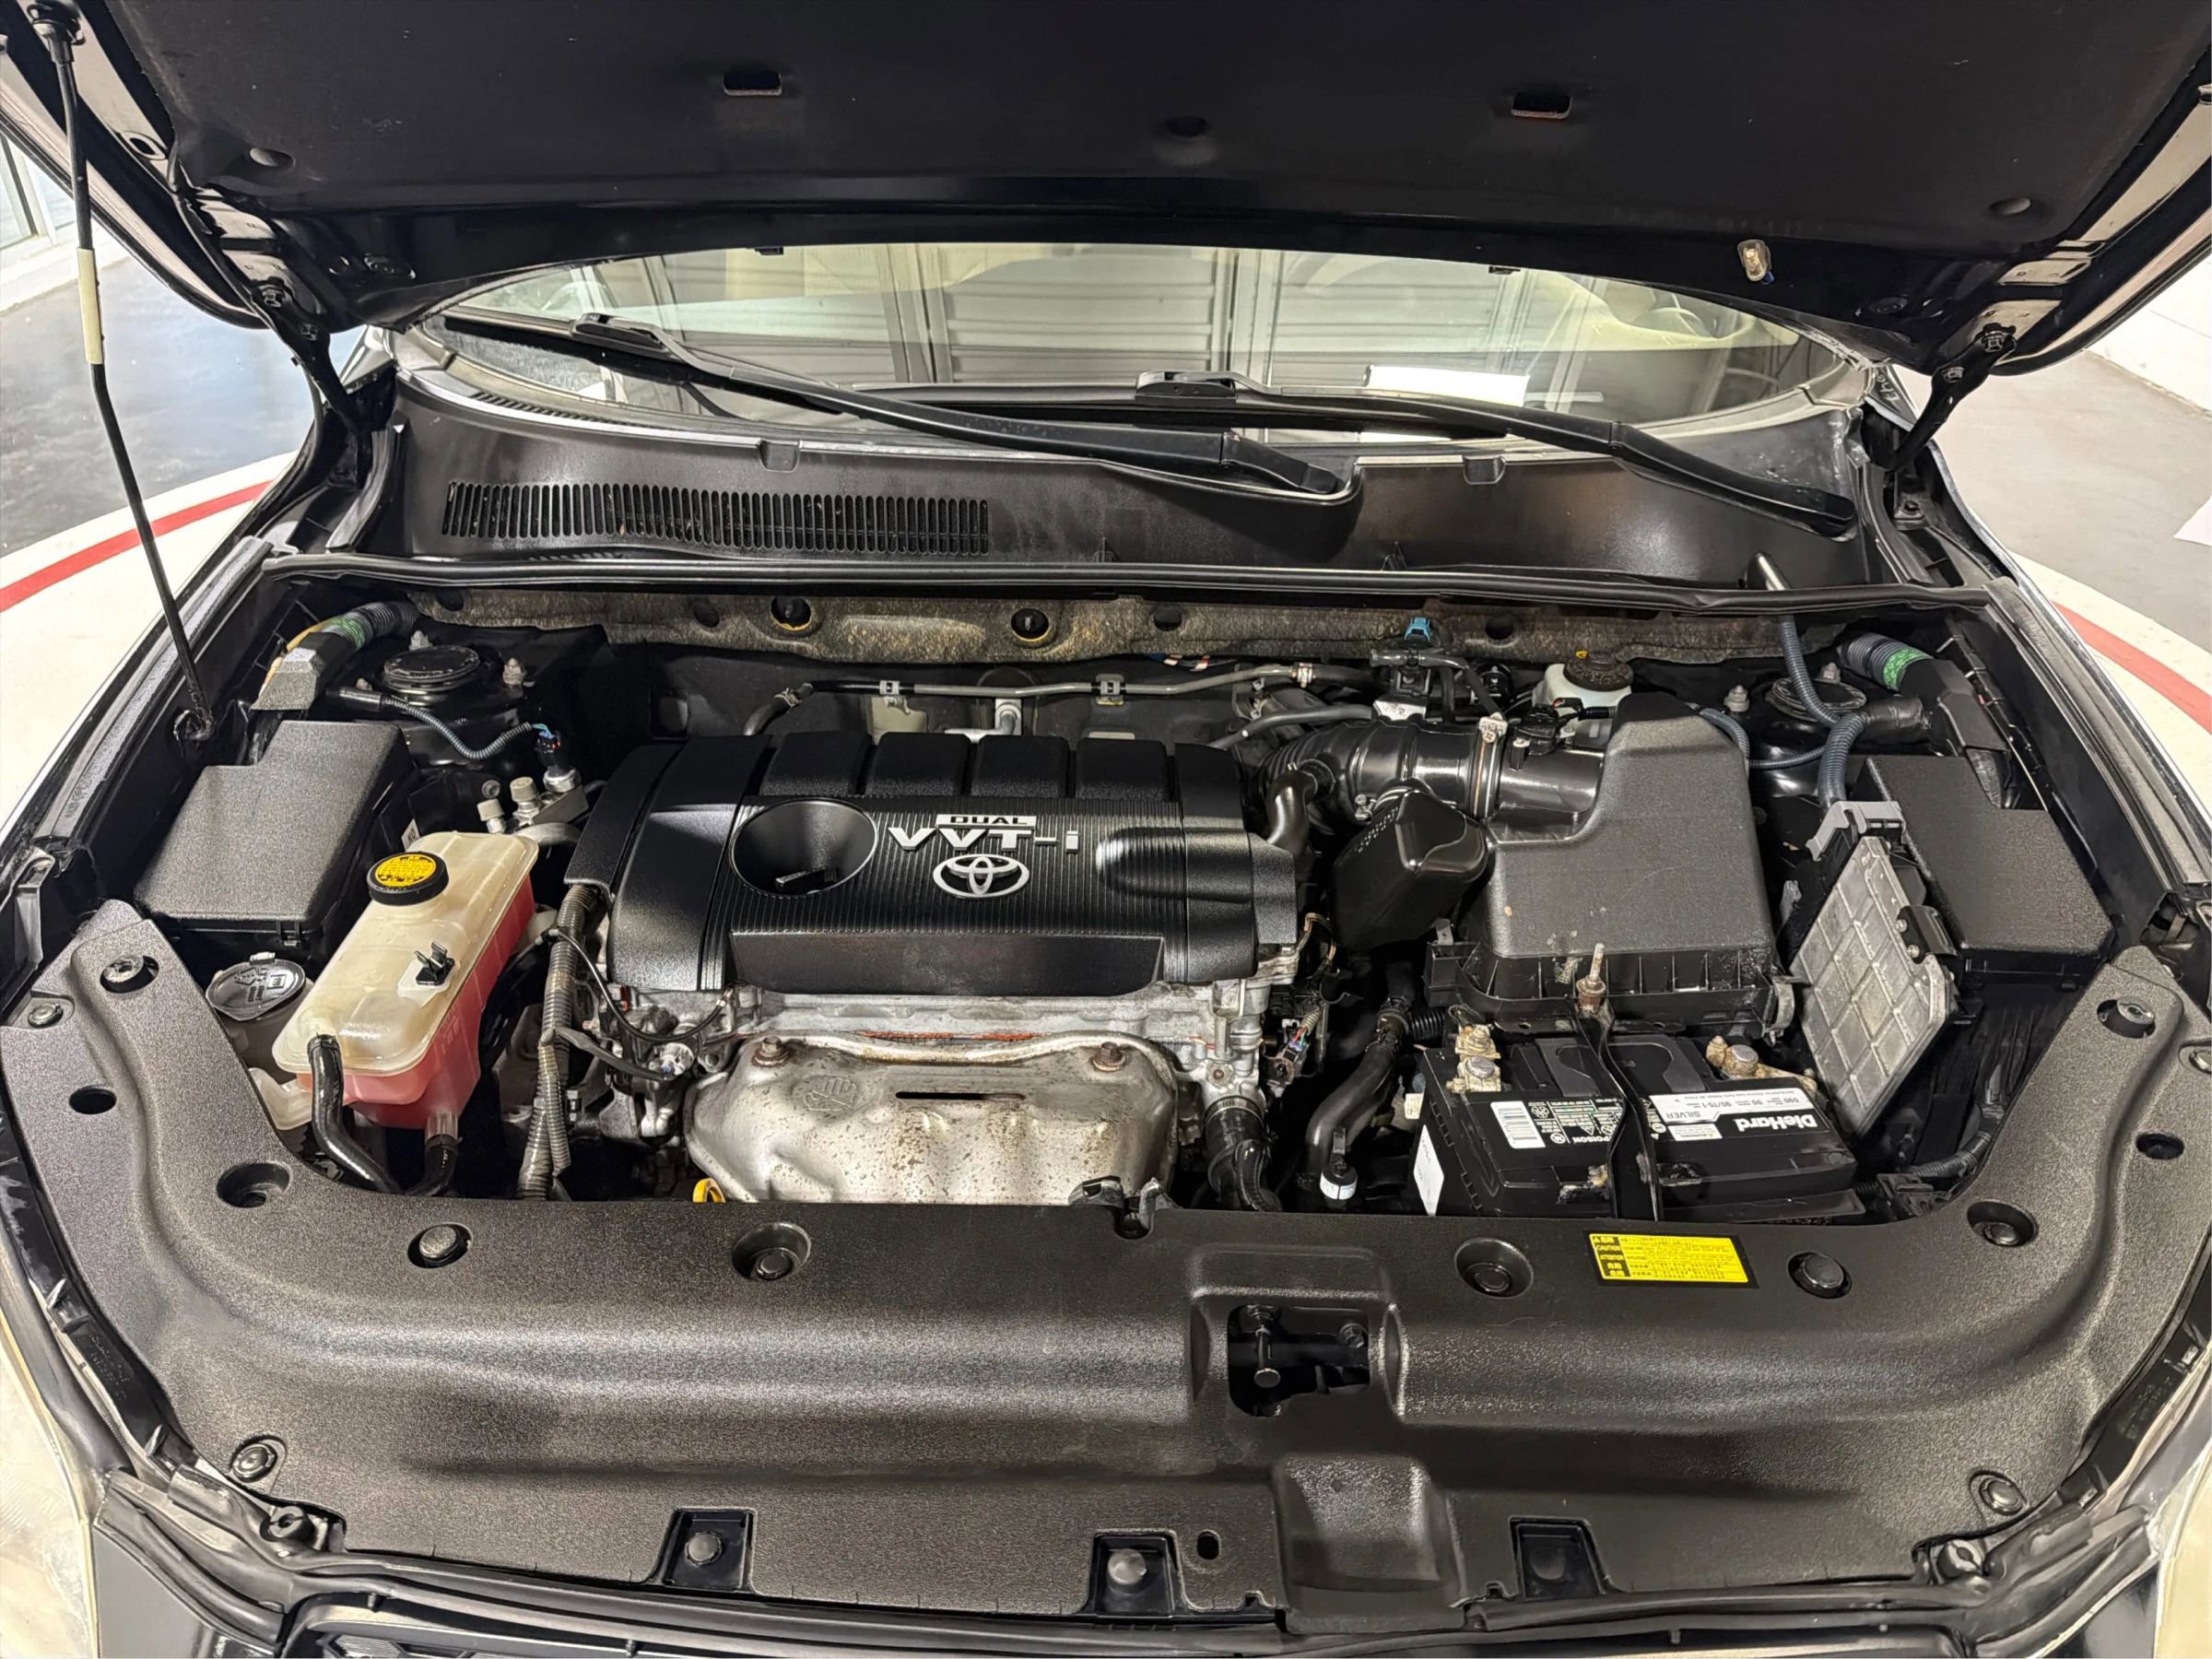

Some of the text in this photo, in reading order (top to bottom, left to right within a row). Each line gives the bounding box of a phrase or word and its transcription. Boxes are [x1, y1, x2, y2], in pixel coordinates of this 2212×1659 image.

[950, 816, 1029, 825] DUAL
[888, 827, 1079, 853] VVT-i
[1665, 1111, 1701, 1120] SILVER
[1734, 1114, 1818, 1132] DieHard
